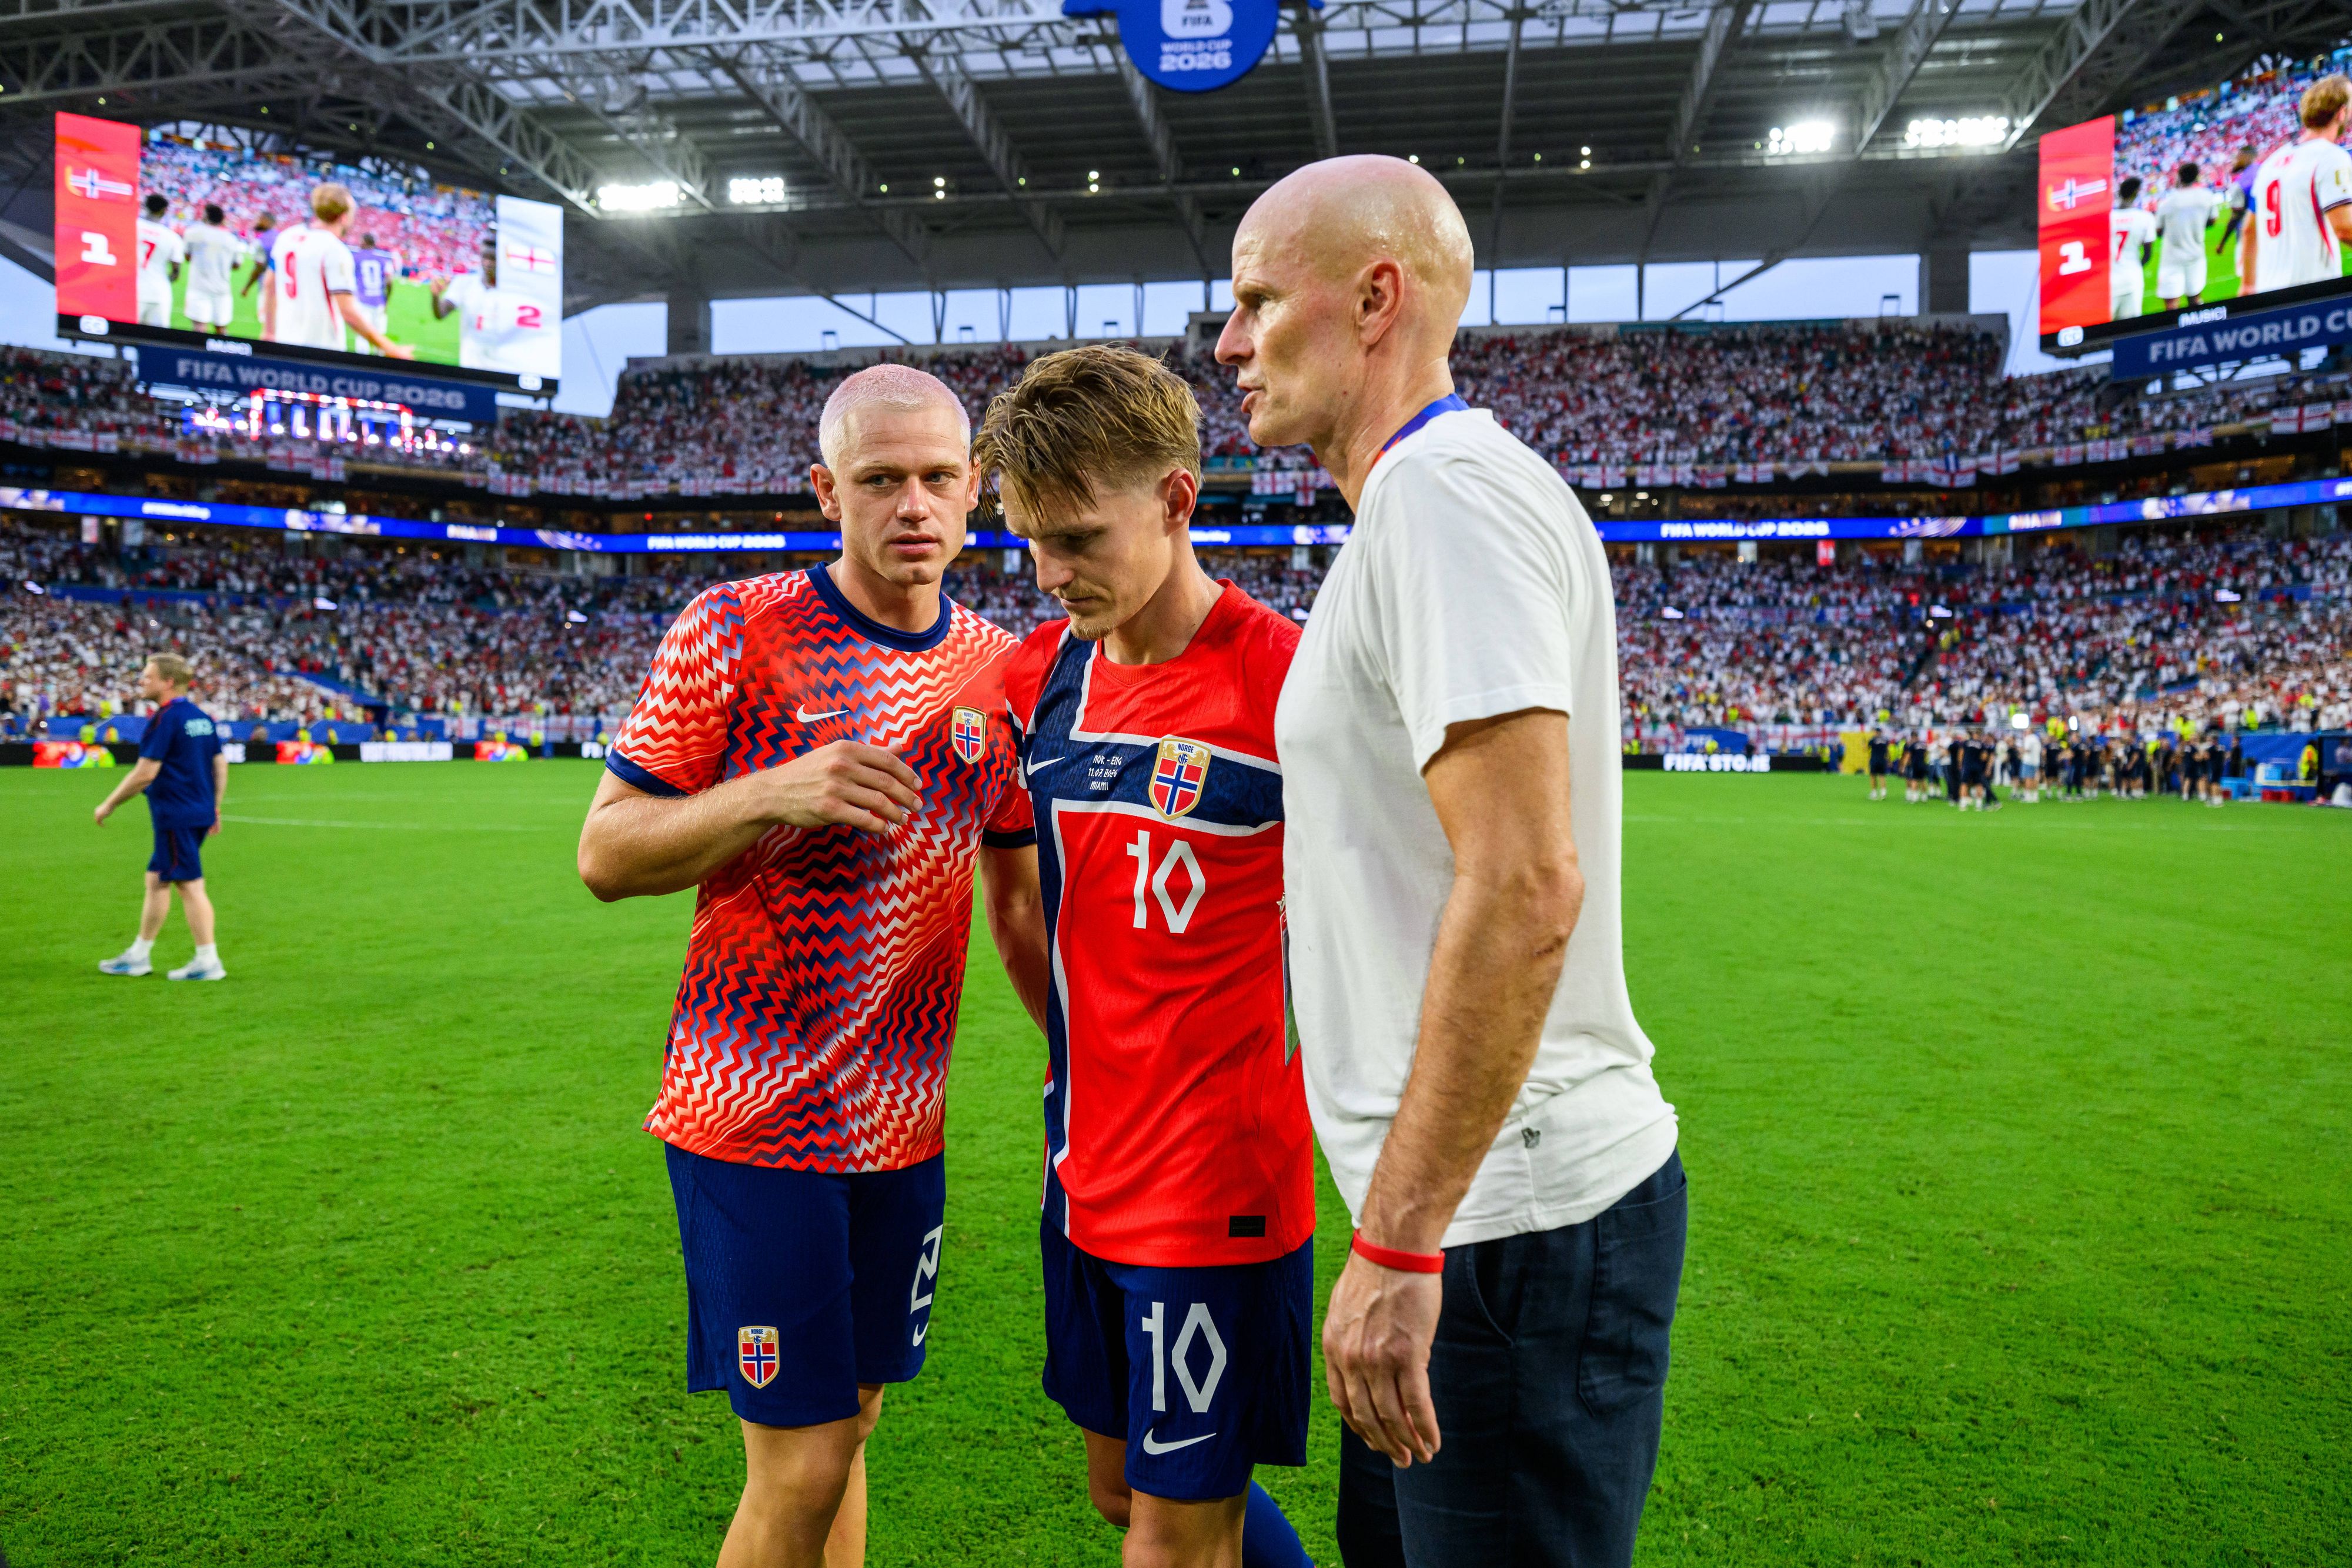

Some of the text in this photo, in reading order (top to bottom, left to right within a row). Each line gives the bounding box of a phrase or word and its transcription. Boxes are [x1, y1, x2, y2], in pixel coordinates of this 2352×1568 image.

[1182, 15, 1212, 25] FIFA
[1161, 39, 1232, 52] WORLD CUP
[1160, 52, 1232, 71] 2026
[2266, 179, 2281, 238] 9
[81, 231, 116, 266] 1
[142, 240, 156, 269] 7
[2059, 240, 2092, 276] 1
[2116, 230, 2130, 263] 7
[285, 251, 298, 299] 9
[516, 305, 542, 328] 2
[2149, 335, 2209, 363] FIFA
[2213, 315, 2321, 353] WORLD
[177, 358, 466, 410] FIFA WORLD CUP 2026
[647, 536, 674, 550] FIFA
[674, 535, 717, 549] WORLD
[717, 535, 742, 549] CUP
[1661, 522, 1693, 538] FIFA
[1693, 522, 1746, 537] WORLD
[1746, 521, 1776, 537] CUP
[1093, 755, 1105, 764] NOR
[1110, 756, 1122, 765] ENG
[1177, 743, 1194, 753] NORGE
[1663, 753, 1707, 772] FIFA
[1090, 781, 1108, 791] MIAMI
[1127, 830, 1206, 934] 10
[1142, 1301, 1227, 1413] 10
